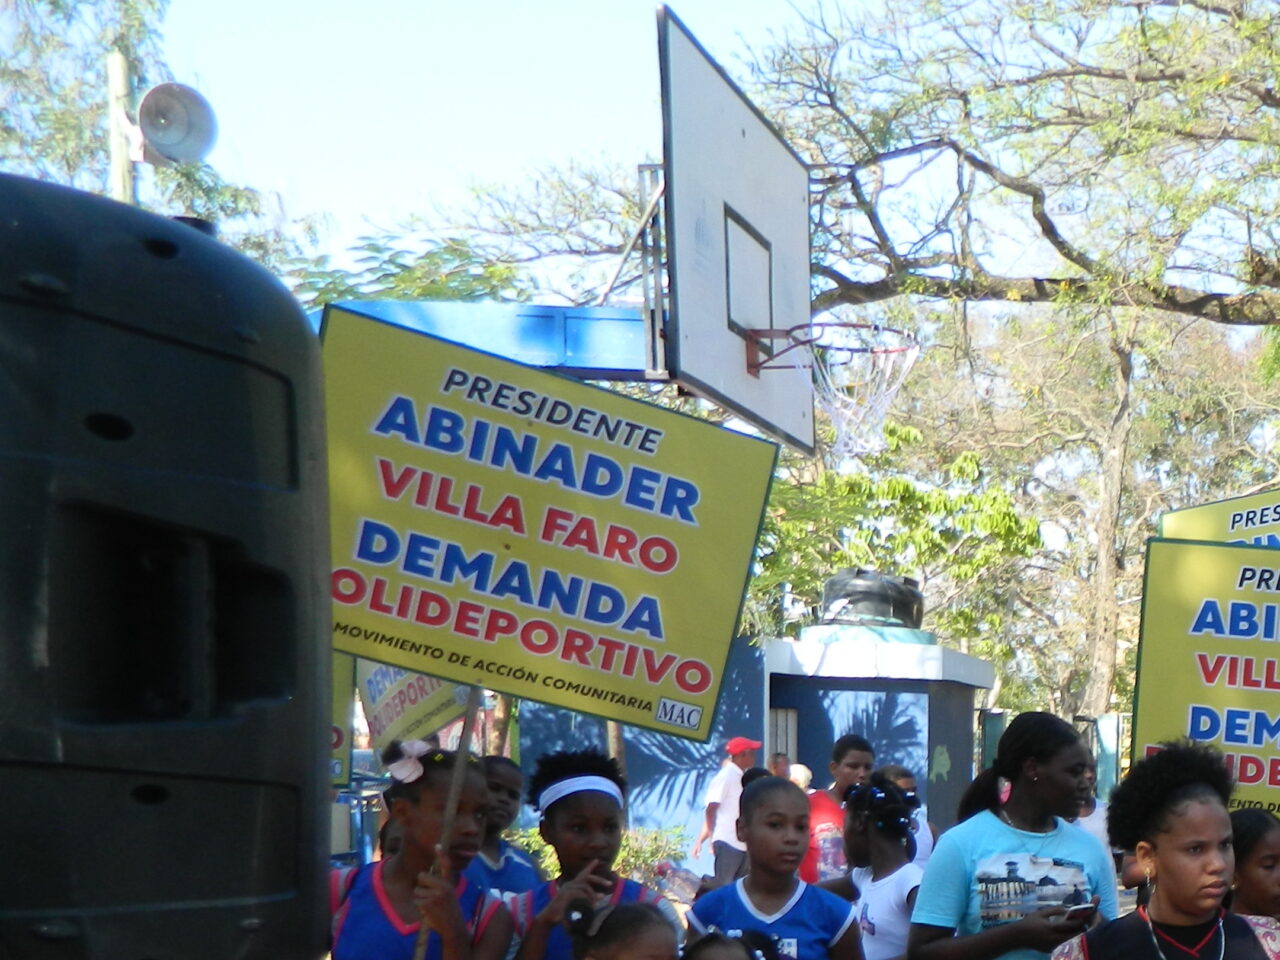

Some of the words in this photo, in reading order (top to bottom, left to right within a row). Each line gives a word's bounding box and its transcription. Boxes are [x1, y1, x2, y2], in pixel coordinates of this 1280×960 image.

[374, 396, 700, 524] ABINADER
[443, 368, 664, 454] PRESIDENTE
[378, 459, 526, 535] VILLA
[540, 508, 679, 574] FARO
[329, 568, 713, 694] OLIDEPORTIVO
[357, 520, 664, 639] DEMANDA
[332, 622, 444, 660] MOVIMIENTO
[447, 651, 471, 667] DE
[473, 657, 539, 686] ACCIÓN
[542, 675, 653, 713] COMUNITARIA
[657, 699, 701, 730] MAC
